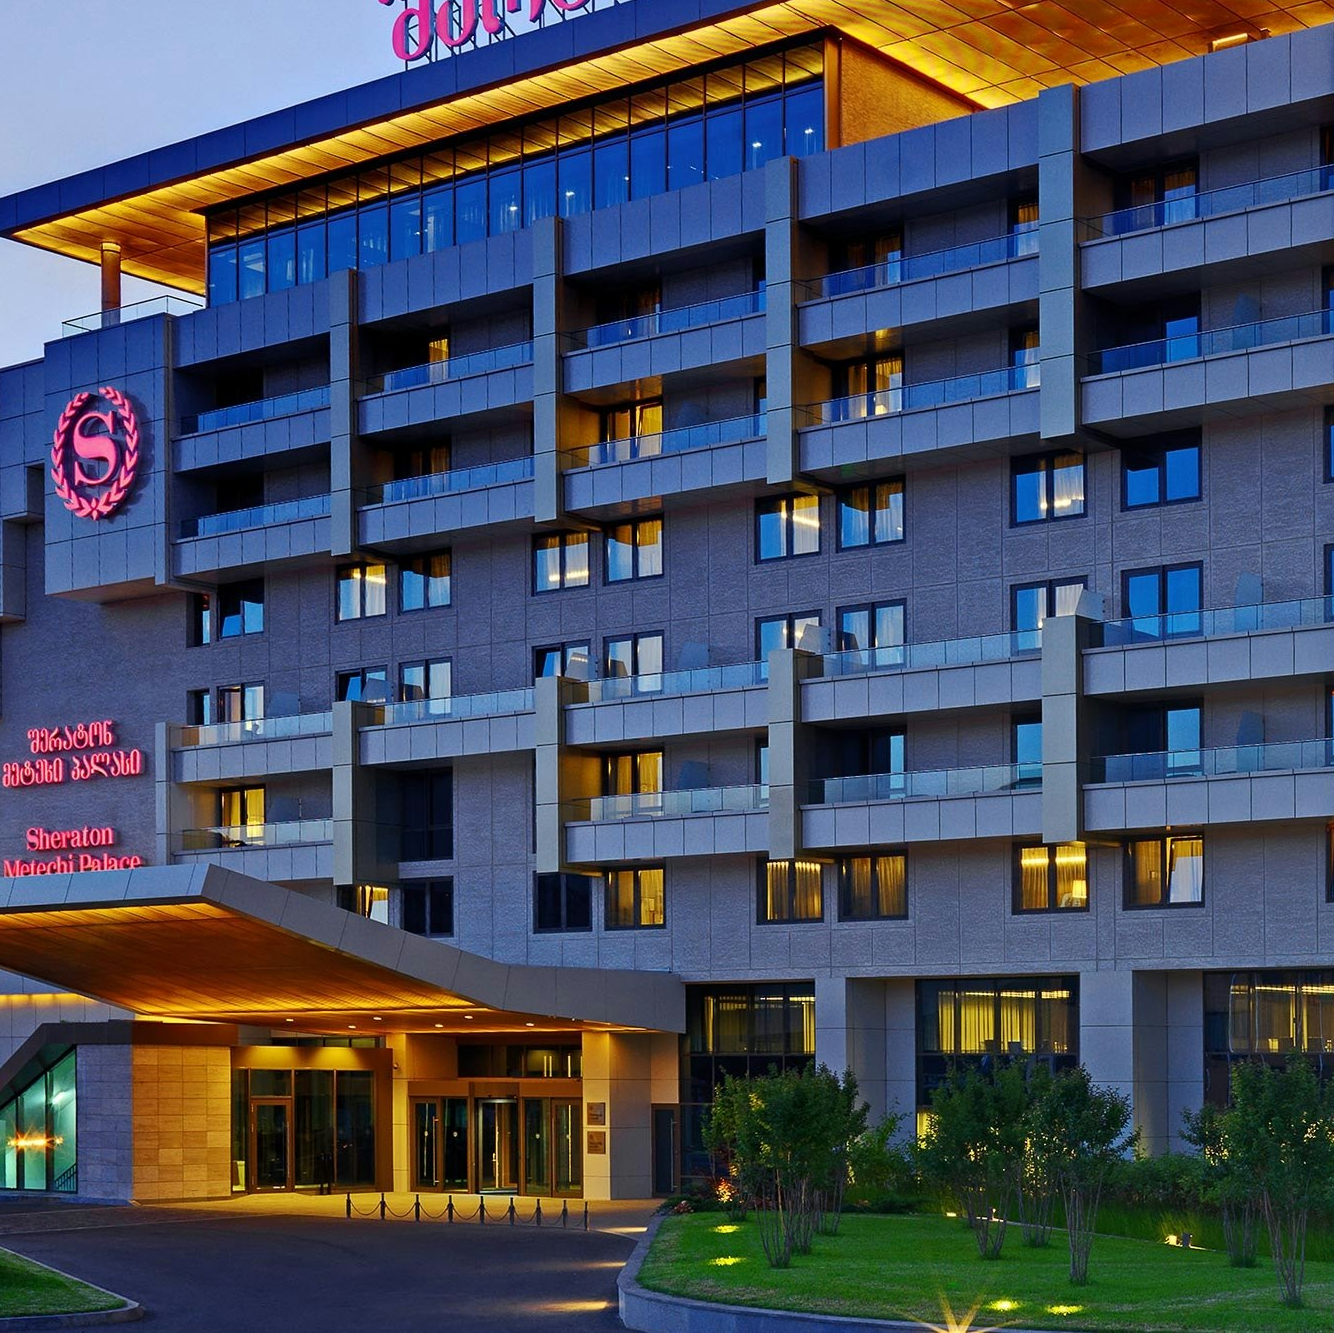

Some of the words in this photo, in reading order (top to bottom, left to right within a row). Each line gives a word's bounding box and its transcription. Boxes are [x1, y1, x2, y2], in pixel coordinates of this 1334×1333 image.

[73, 410, 117, 486] S
[27, 719, 114, 754] შერატონ
[2, 757, 64, 788] მეტეხი
[71, 749, 142, 780] პალასი
[26, 826, 113, 851] Sheraton
[3, 853, 73, 878] Metechi
[79, 853, 141, 872] Palace
